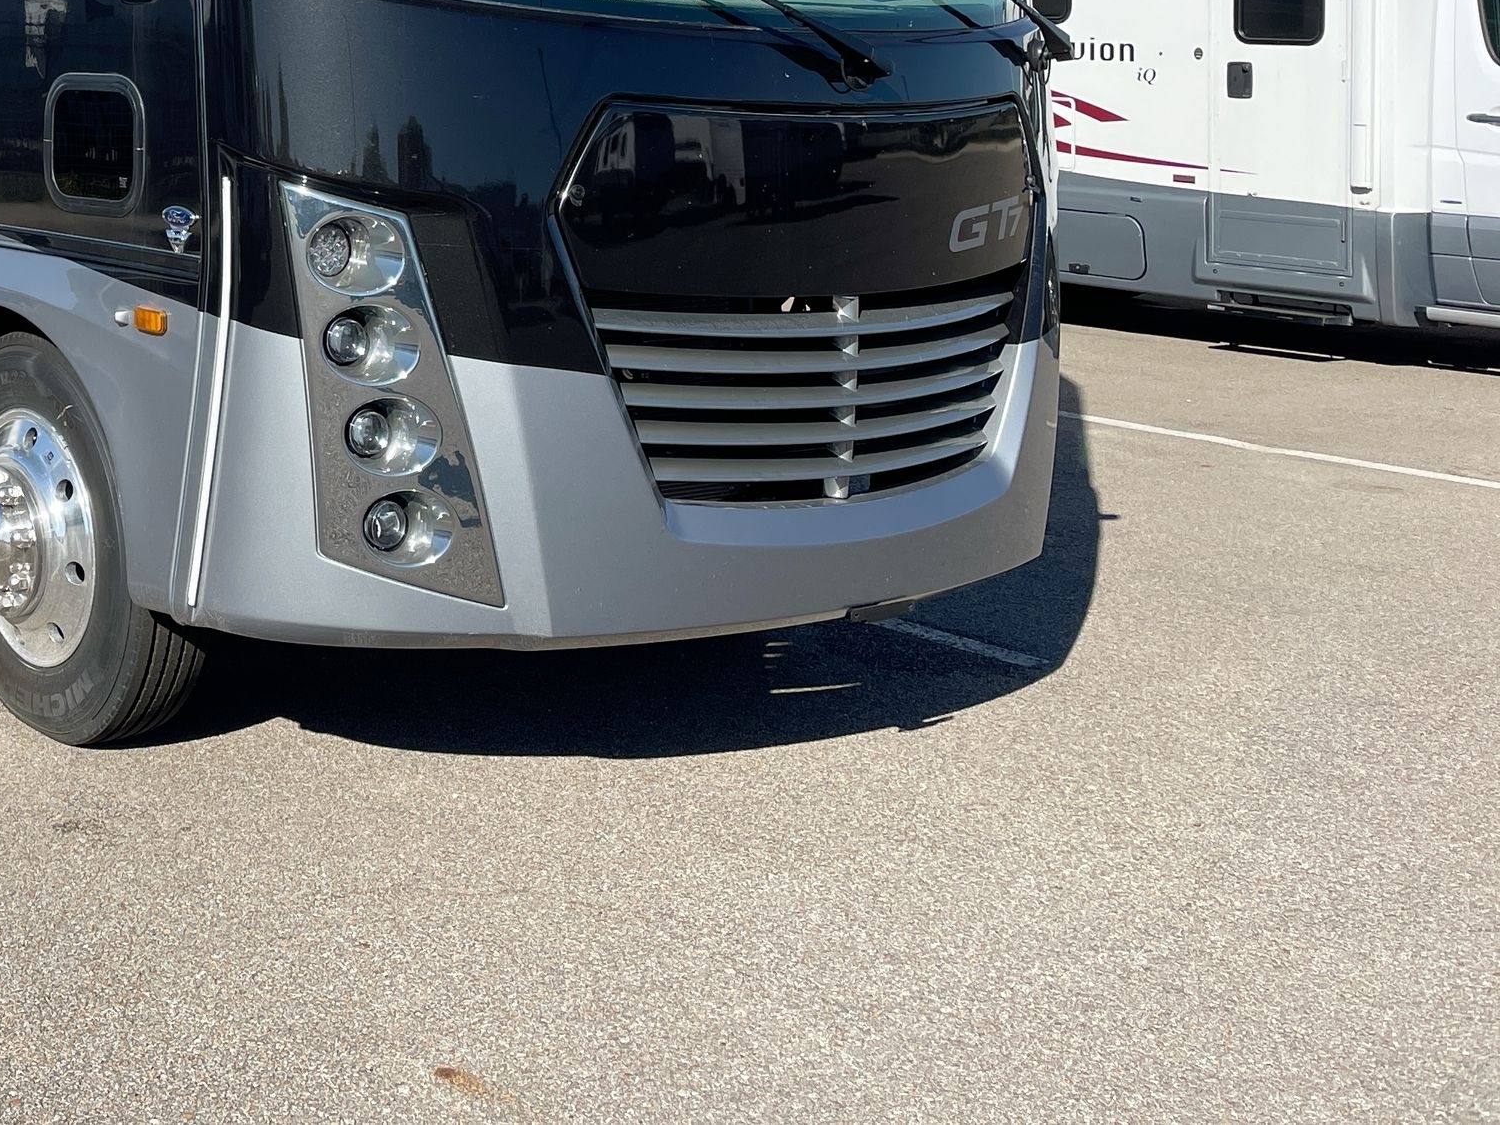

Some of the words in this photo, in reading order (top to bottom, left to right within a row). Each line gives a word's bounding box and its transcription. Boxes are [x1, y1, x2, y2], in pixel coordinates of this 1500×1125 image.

[1072, 37, 1135, 62] vion
[1136, 67, 1157, 85] iQ
[948, 195, 1025, 253] GT7
